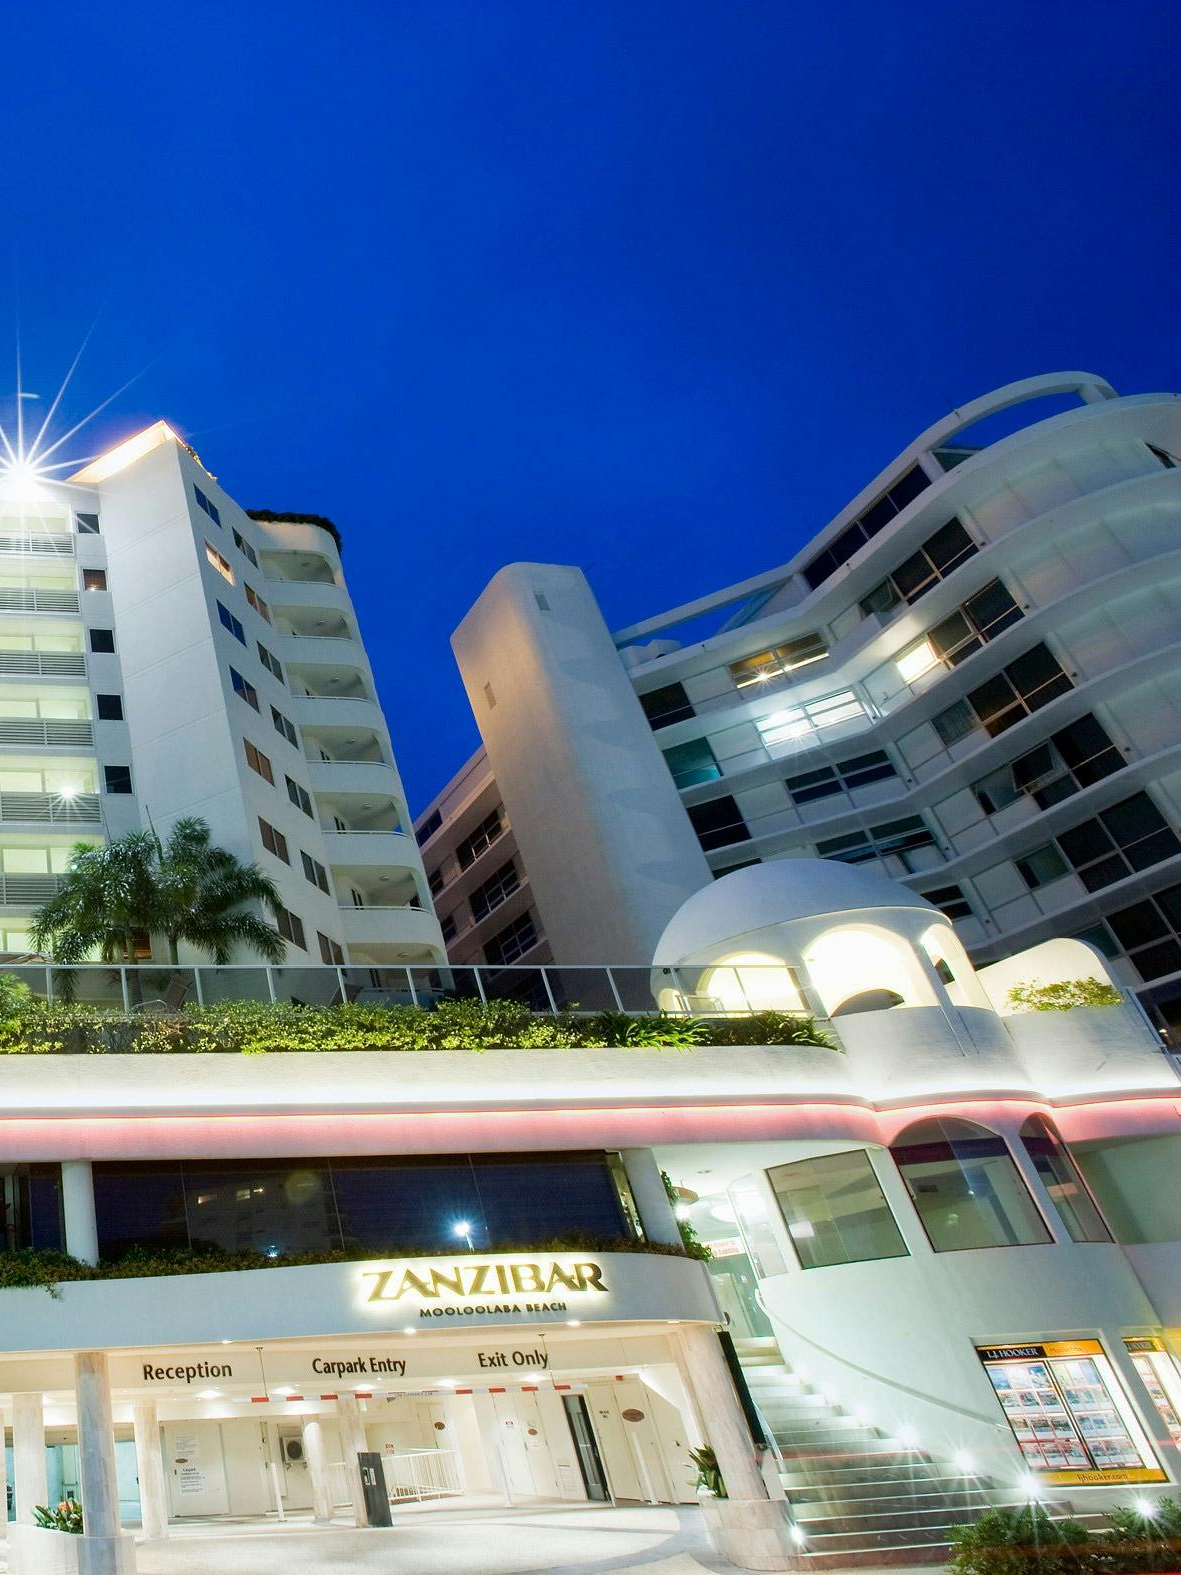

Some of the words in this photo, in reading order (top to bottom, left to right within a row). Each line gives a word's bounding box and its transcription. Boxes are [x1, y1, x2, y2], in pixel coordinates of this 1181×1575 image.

[362, 1261, 609, 1302] ZANZIBAR
[419, 1303, 521, 1318] MOOLOOLABA
[526, 1301, 567, 1313] BEACH
[478, 1351, 509, 1368] Exit
[512, 1350, 549, 1369] Only
[999, 1348, 1038, 1357] HOOKER
[142, 1361, 232, 1384] Reception
[312, 1358, 367, 1379] Carpark
[370, 1357, 406, 1376] Entry
